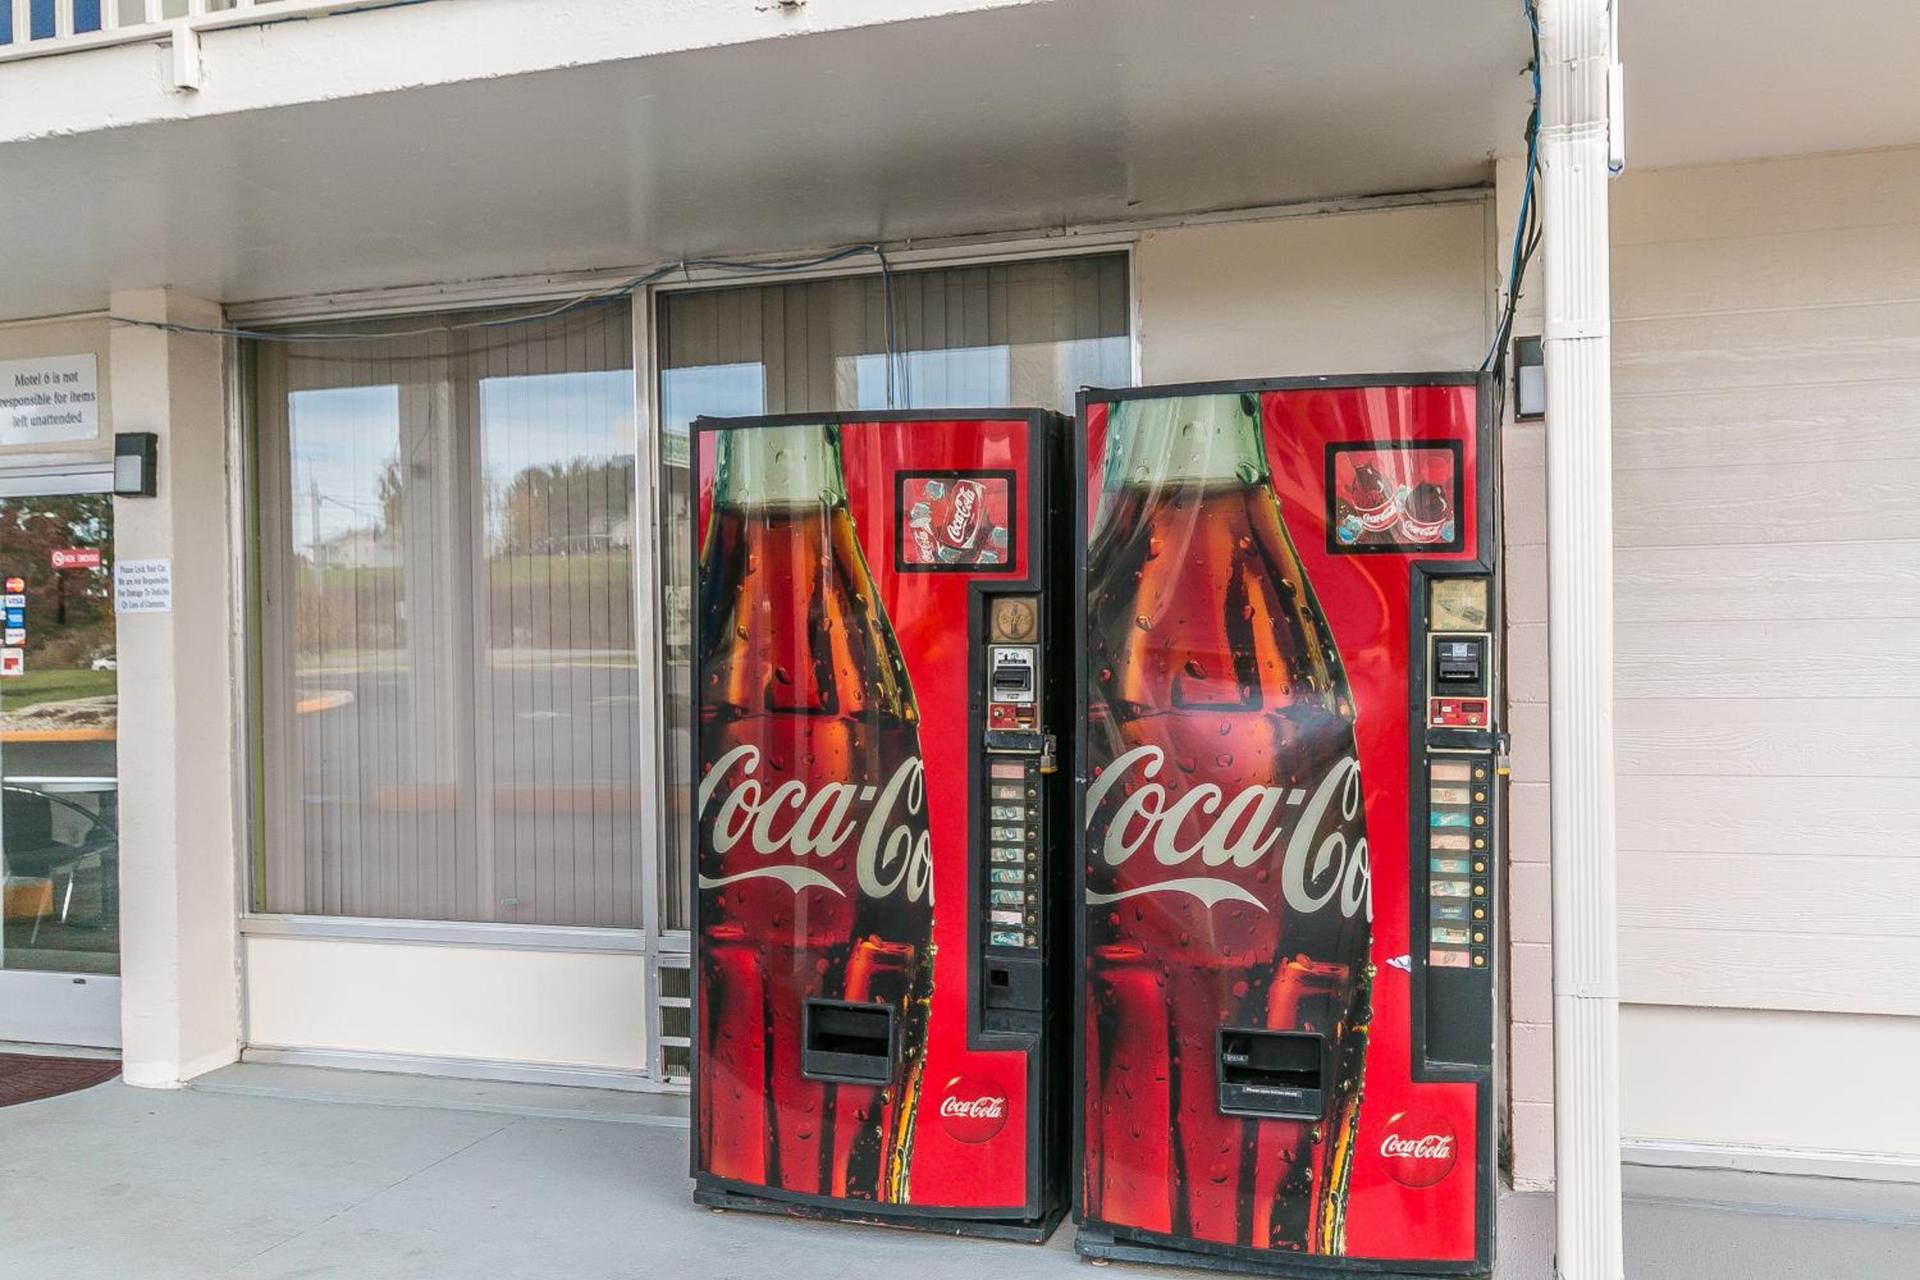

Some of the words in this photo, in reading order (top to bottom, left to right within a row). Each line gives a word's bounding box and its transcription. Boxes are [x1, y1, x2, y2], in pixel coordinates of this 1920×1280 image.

[15, 373, 41, 387] Motel
[44, 372, 50, 385] 6
[52, 370, 60, 384] is
[63, 371, 78, 383] not
[54, 391, 67, 404] for
[70, 391, 95, 403] items
[12, 414, 28, 427] left
[30, 411, 82, 426] unattended
[699, 744, 934, 907] Coca-Co
[1086, 744, 1373, 923] Coca-Co
[940, 1096, 1006, 1118] Coca-Cola
[1380, 1133, 1455, 1159] Coca-Cola
